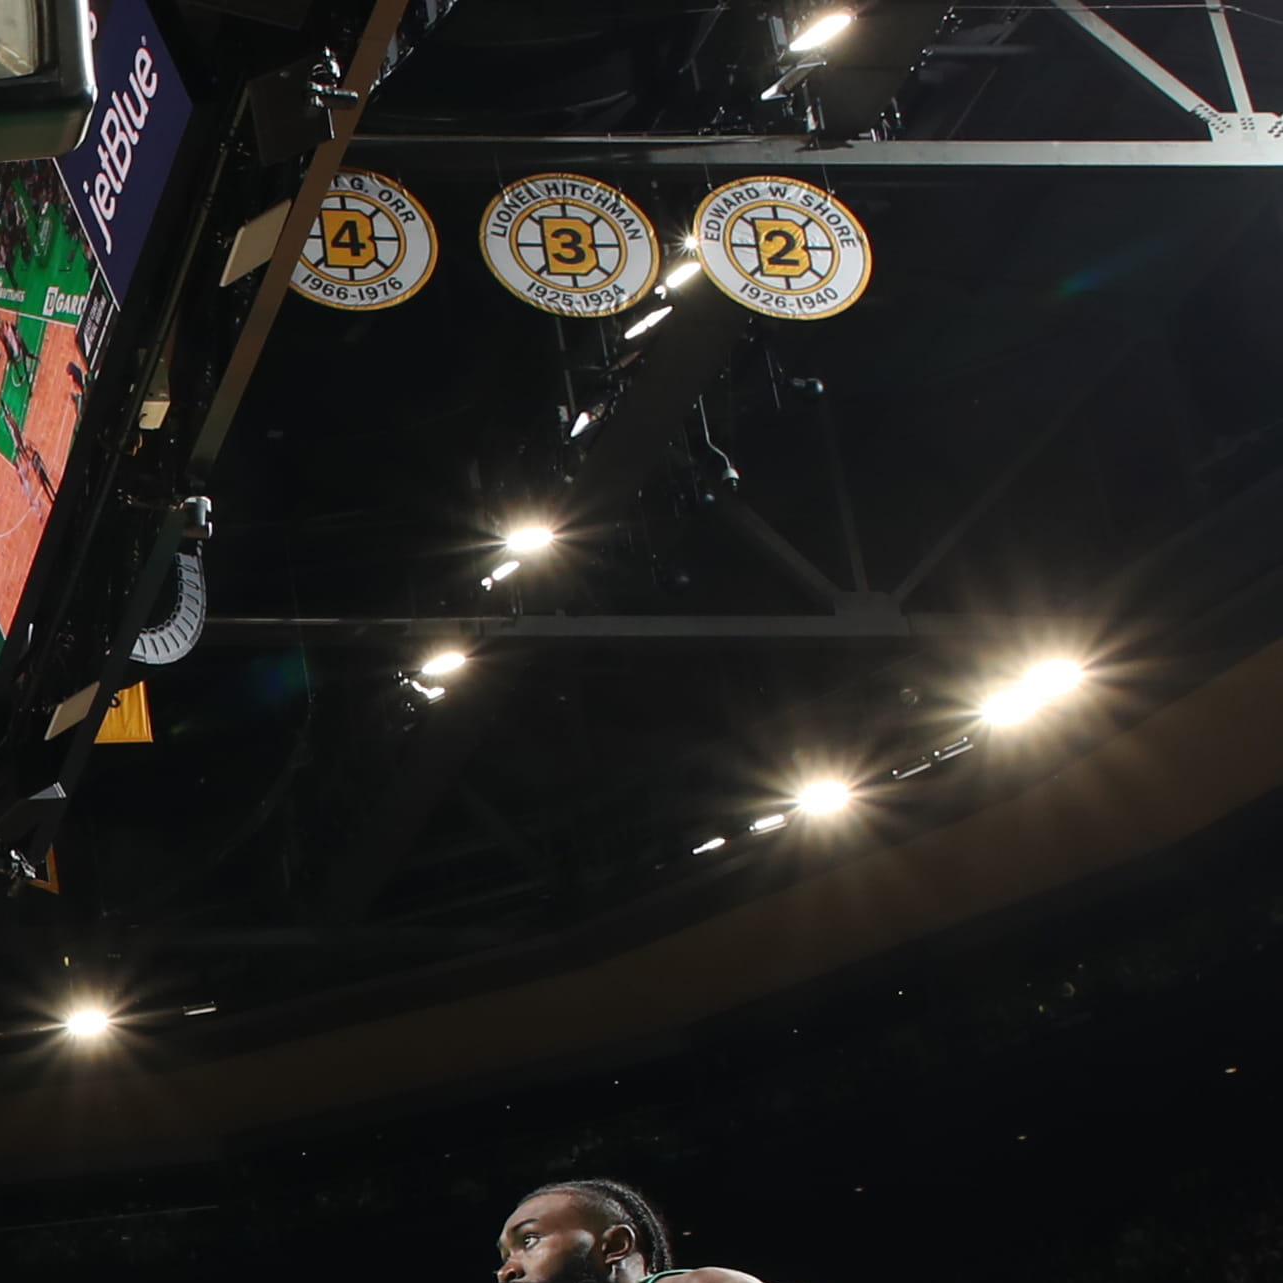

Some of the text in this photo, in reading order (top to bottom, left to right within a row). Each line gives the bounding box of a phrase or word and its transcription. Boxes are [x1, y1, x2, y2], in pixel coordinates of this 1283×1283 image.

[84, 52, 159, 254] jetBlue
[377, 190, 416, 225] ORR
[491, 184, 643, 242] LIONEL HITCHMAN
[705, 186, 761, 242] EDWARD
[802, 191, 857, 250] SHORE
[334, 219, 367, 257] 4
[551, 227, 587, 265] 3
[765, 229, 800, 266] 2
[301, 272, 404, 302] 1966-1976
[525, 281, 626, 312] 1925-1934
[739, 281, 839, 310] 1926-1940
